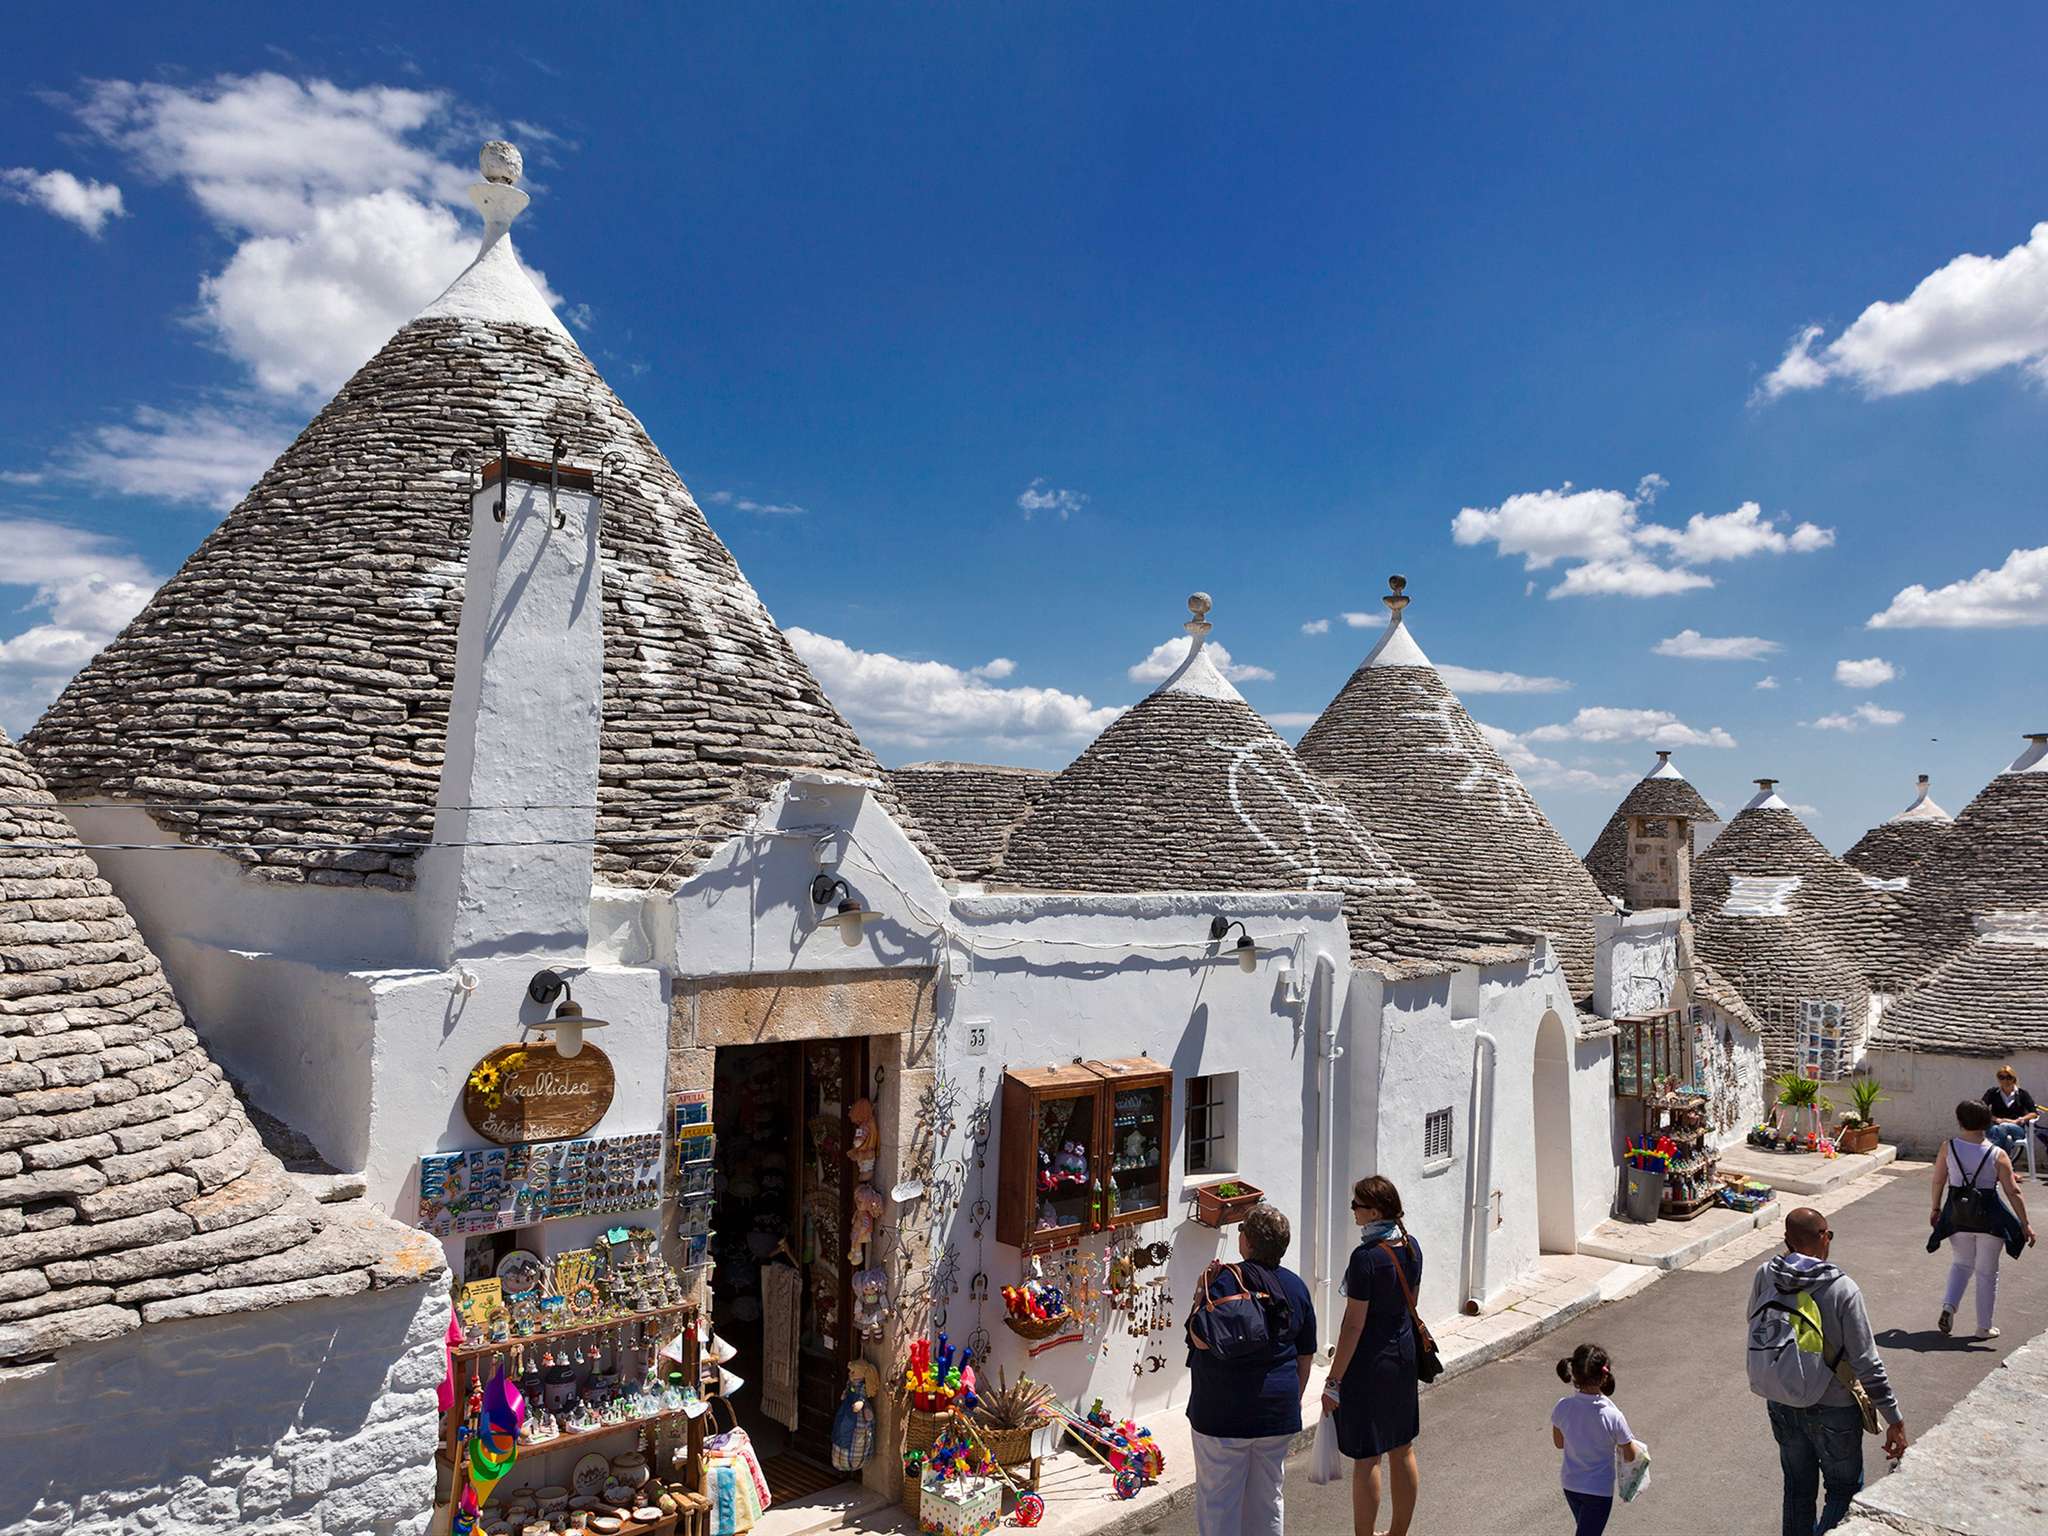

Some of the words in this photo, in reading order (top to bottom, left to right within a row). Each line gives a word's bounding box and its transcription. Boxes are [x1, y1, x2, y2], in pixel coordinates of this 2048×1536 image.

[970, 1029, 985, 1047] 33
[678, 1093, 705, 1103] APULIA
[684, 1127, 711, 1137] PUGLIA
